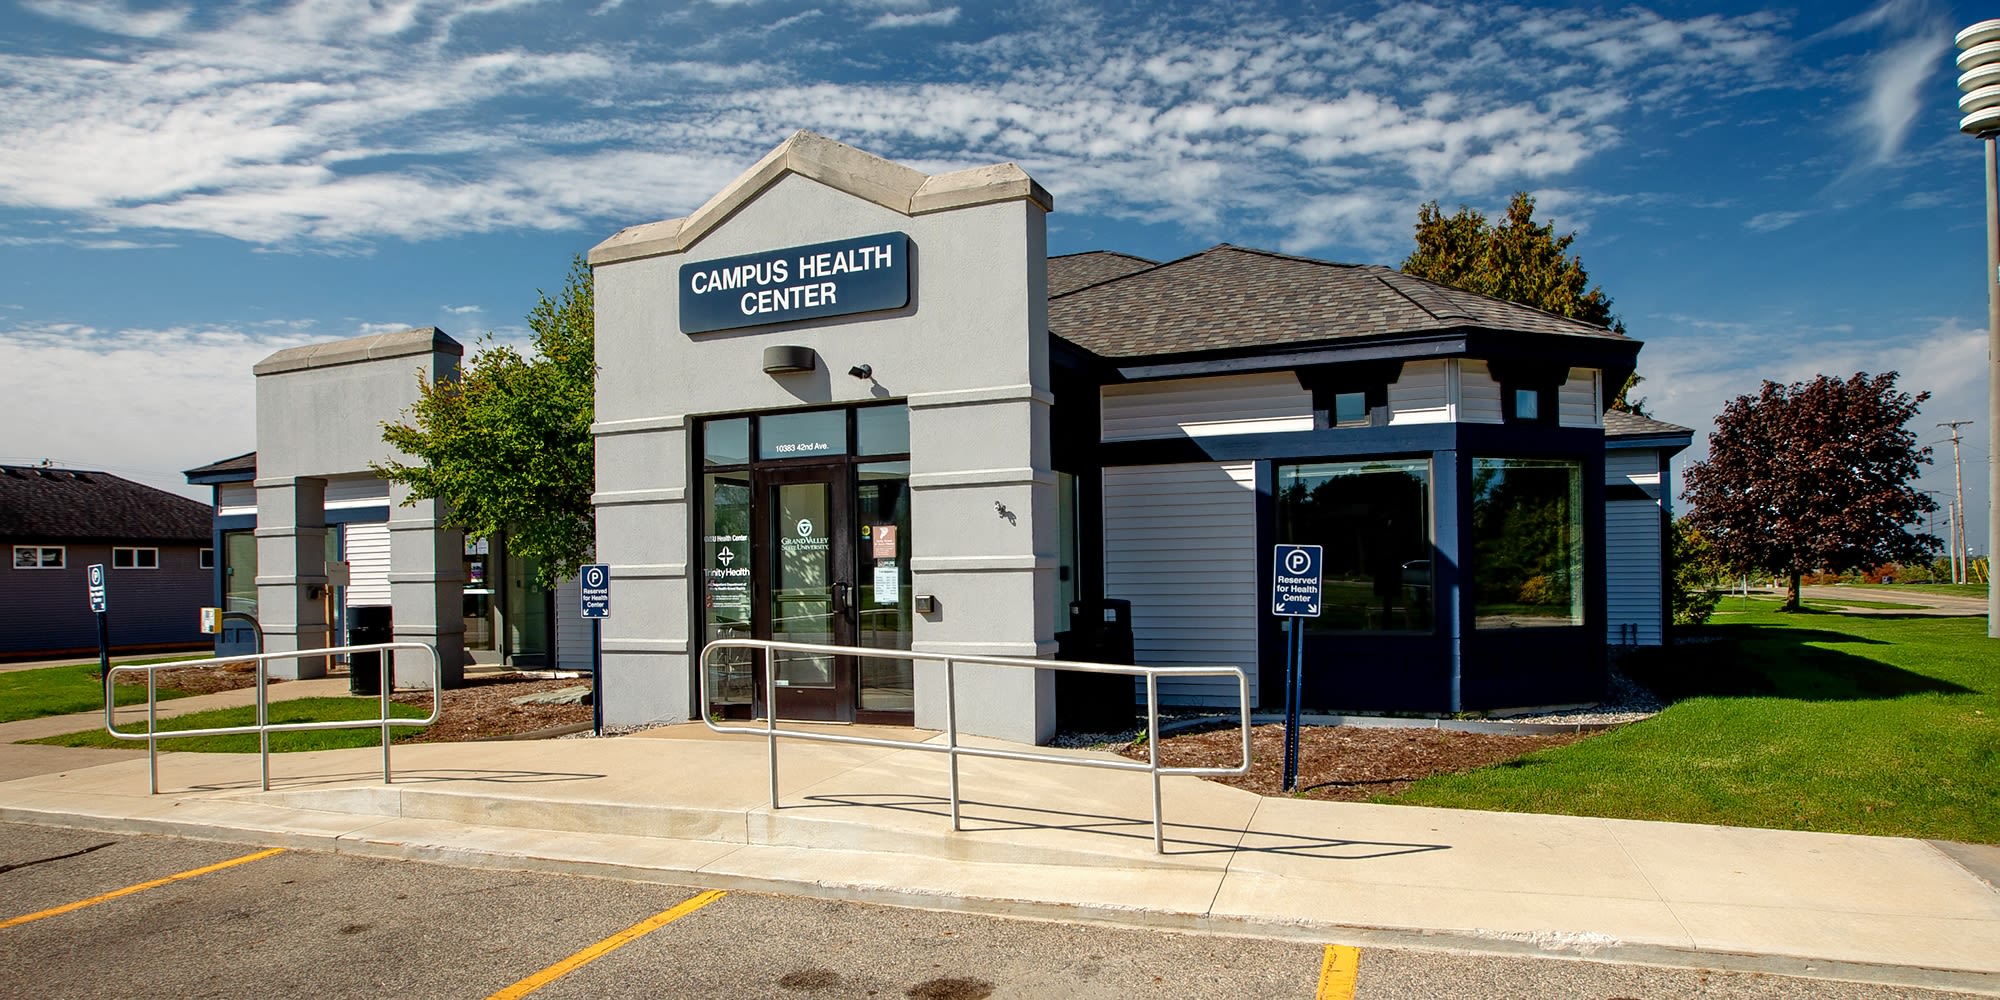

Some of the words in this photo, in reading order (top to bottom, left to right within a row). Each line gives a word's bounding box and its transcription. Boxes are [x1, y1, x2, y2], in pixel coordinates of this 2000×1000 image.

[692, 260, 788, 294] CAMPUS
[799, 244, 892, 280] HEALTH
[741, 282, 836, 315] CENTER
[776, 444, 796, 452] 10383
[796, 443, 814, 451] 42nd
[814, 442, 830, 450] Ave.
[732, 534, 747, 542] Center
[1293, 555, 1304, 569] P
[591, 572, 599, 583] P
[704, 568, 726, 578] Trinity
[725, 567, 751, 577] Health
[1278, 576, 1317, 584] Reserved
[1276, 584, 1289, 592] for
[1290, 585, 1318, 593] Health
[1283, 594, 1311, 602] Center
